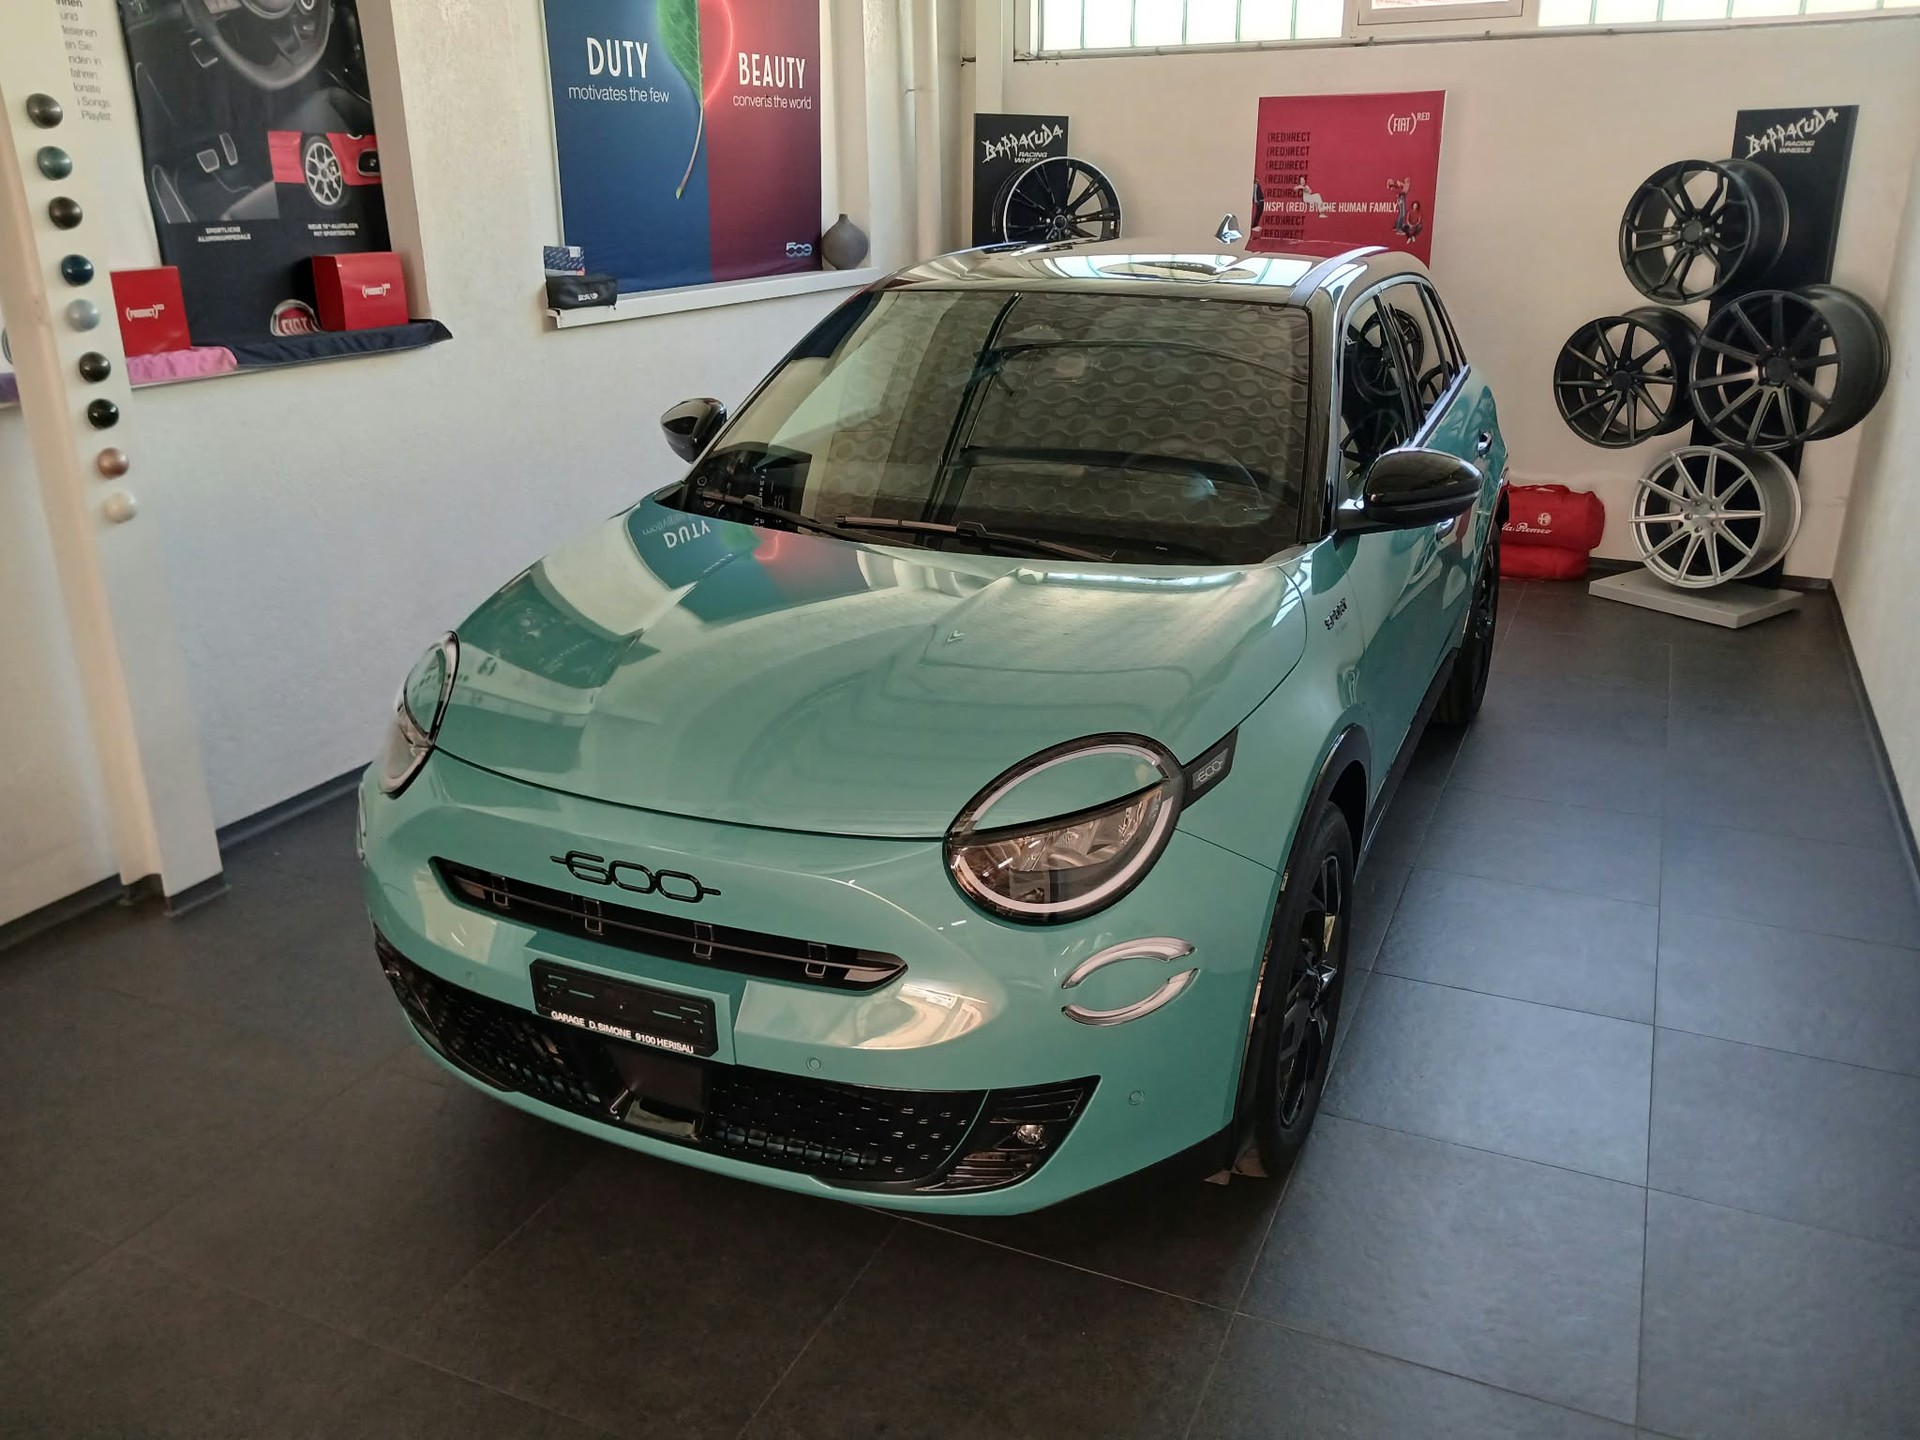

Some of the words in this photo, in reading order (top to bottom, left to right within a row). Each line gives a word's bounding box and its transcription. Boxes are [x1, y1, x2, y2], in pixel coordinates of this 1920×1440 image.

[586, 37, 648, 78] DUTY
[738, 52, 806, 89] BEAUTY
[568, 85, 628, 101] motivates
[629, 87, 648, 102] the
[649, 87, 670, 103] few
[732, 94, 773, 108] converts
[774, 94, 788, 109] the
[789, 96, 812, 110] world
[981, 123, 1064, 163] BARRACUDA
[1744, 108, 1839, 160] BARRACUDA
[1286, 201, 1308, 213] (RED)
[1338, 202, 1367, 213] HUMAN
[1369, 202, 1399, 213] FAMILY.
[785, 242, 813, 257] 500
[1516, 522, 1553, 534] Romeo
[549, 850, 722, 904] 600
[550, 1010, 586, 1027] GARAGE
[635, 1032, 657, 1046] 9100
[656, 1037, 695, 1054] HERISAU
